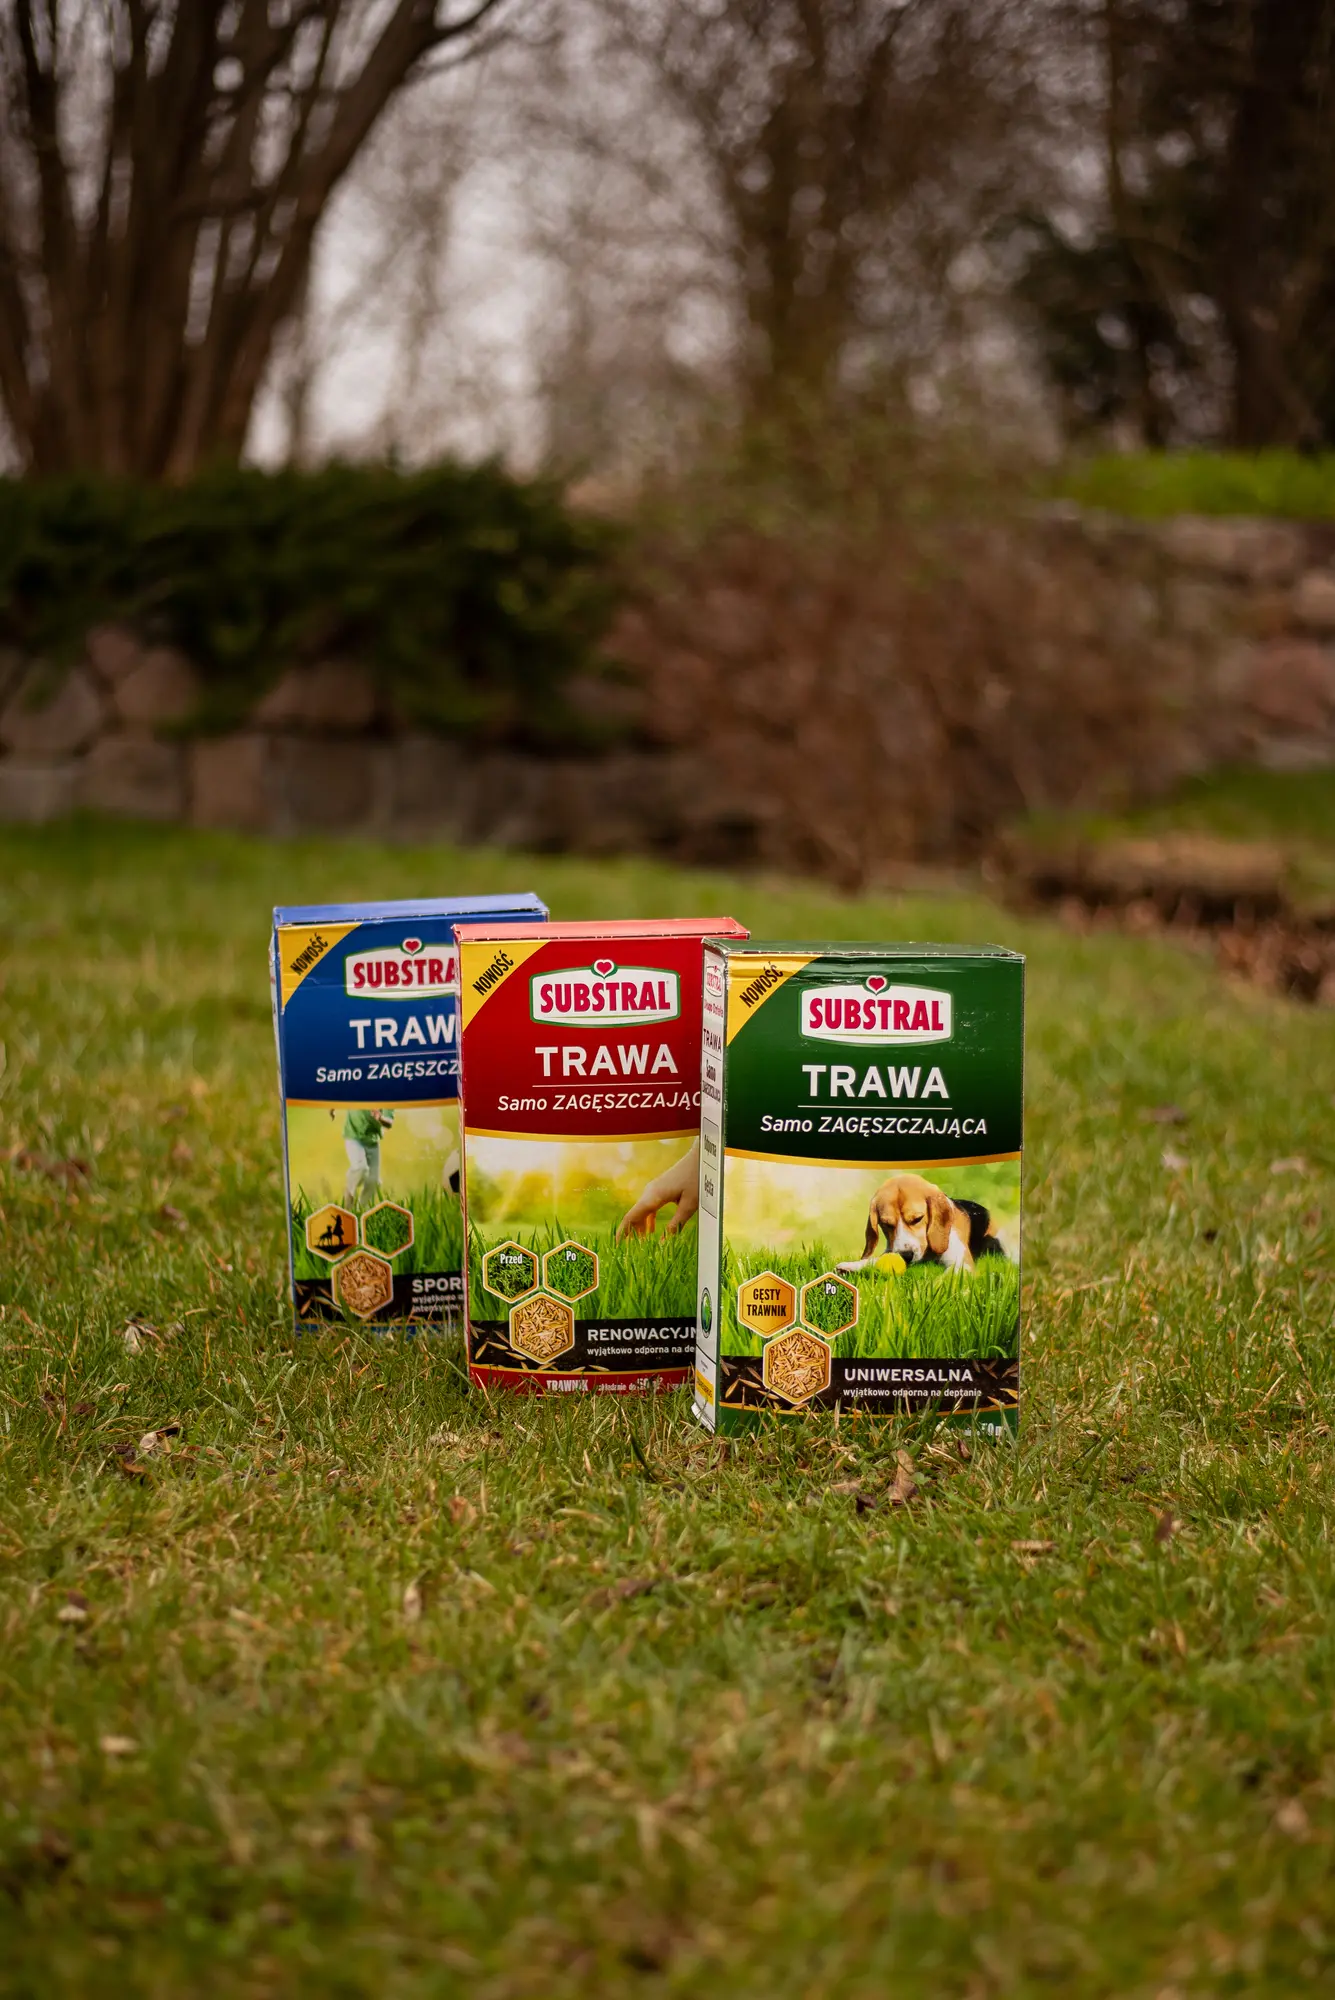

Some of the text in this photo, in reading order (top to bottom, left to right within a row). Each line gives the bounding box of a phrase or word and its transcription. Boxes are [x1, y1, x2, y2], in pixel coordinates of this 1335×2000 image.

[290, 932, 328, 976] NOWOŚĆ
[472, 950, 514, 996] NOWOŚĆ
[739, 960, 784, 1008] NOWOŚĆ
[540, 980, 671, 1013] SUBSTRAL
[809, 997, 944, 1031] SUBSTRAL
[535, 1043, 679, 1077] TRAWA
[316, 1066, 362, 1082] Samo
[802, 1064, 949, 1099] TRAWA
[498, 1095, 547, 1111] Samo
[760, 1115, 988, 1139] Samo ZAGĘSZCZAJĄCA
[500, 1254, 523, 1264] Przed
[566, 1250, 577, 1261] Po
[752, 1288, 781, 1303] GĘSTY
[825, 1283, 837, 1295] Po
[746, 1303, 787, 1317] TRAWNIK
[587, 1346, 632, 1356] wyjątkowo
[634, 1345, 669, 1356] odporna
[844, 1368, 974, 1382] UNIWERSALNA
[546, 1379, 589, 1392] TRAWNIK
[843, 1388, 890, 1398] wyjątkowo
[892, 1388, 928, 1397] odporna
[943, 1388, 982, 1398] deptanie
